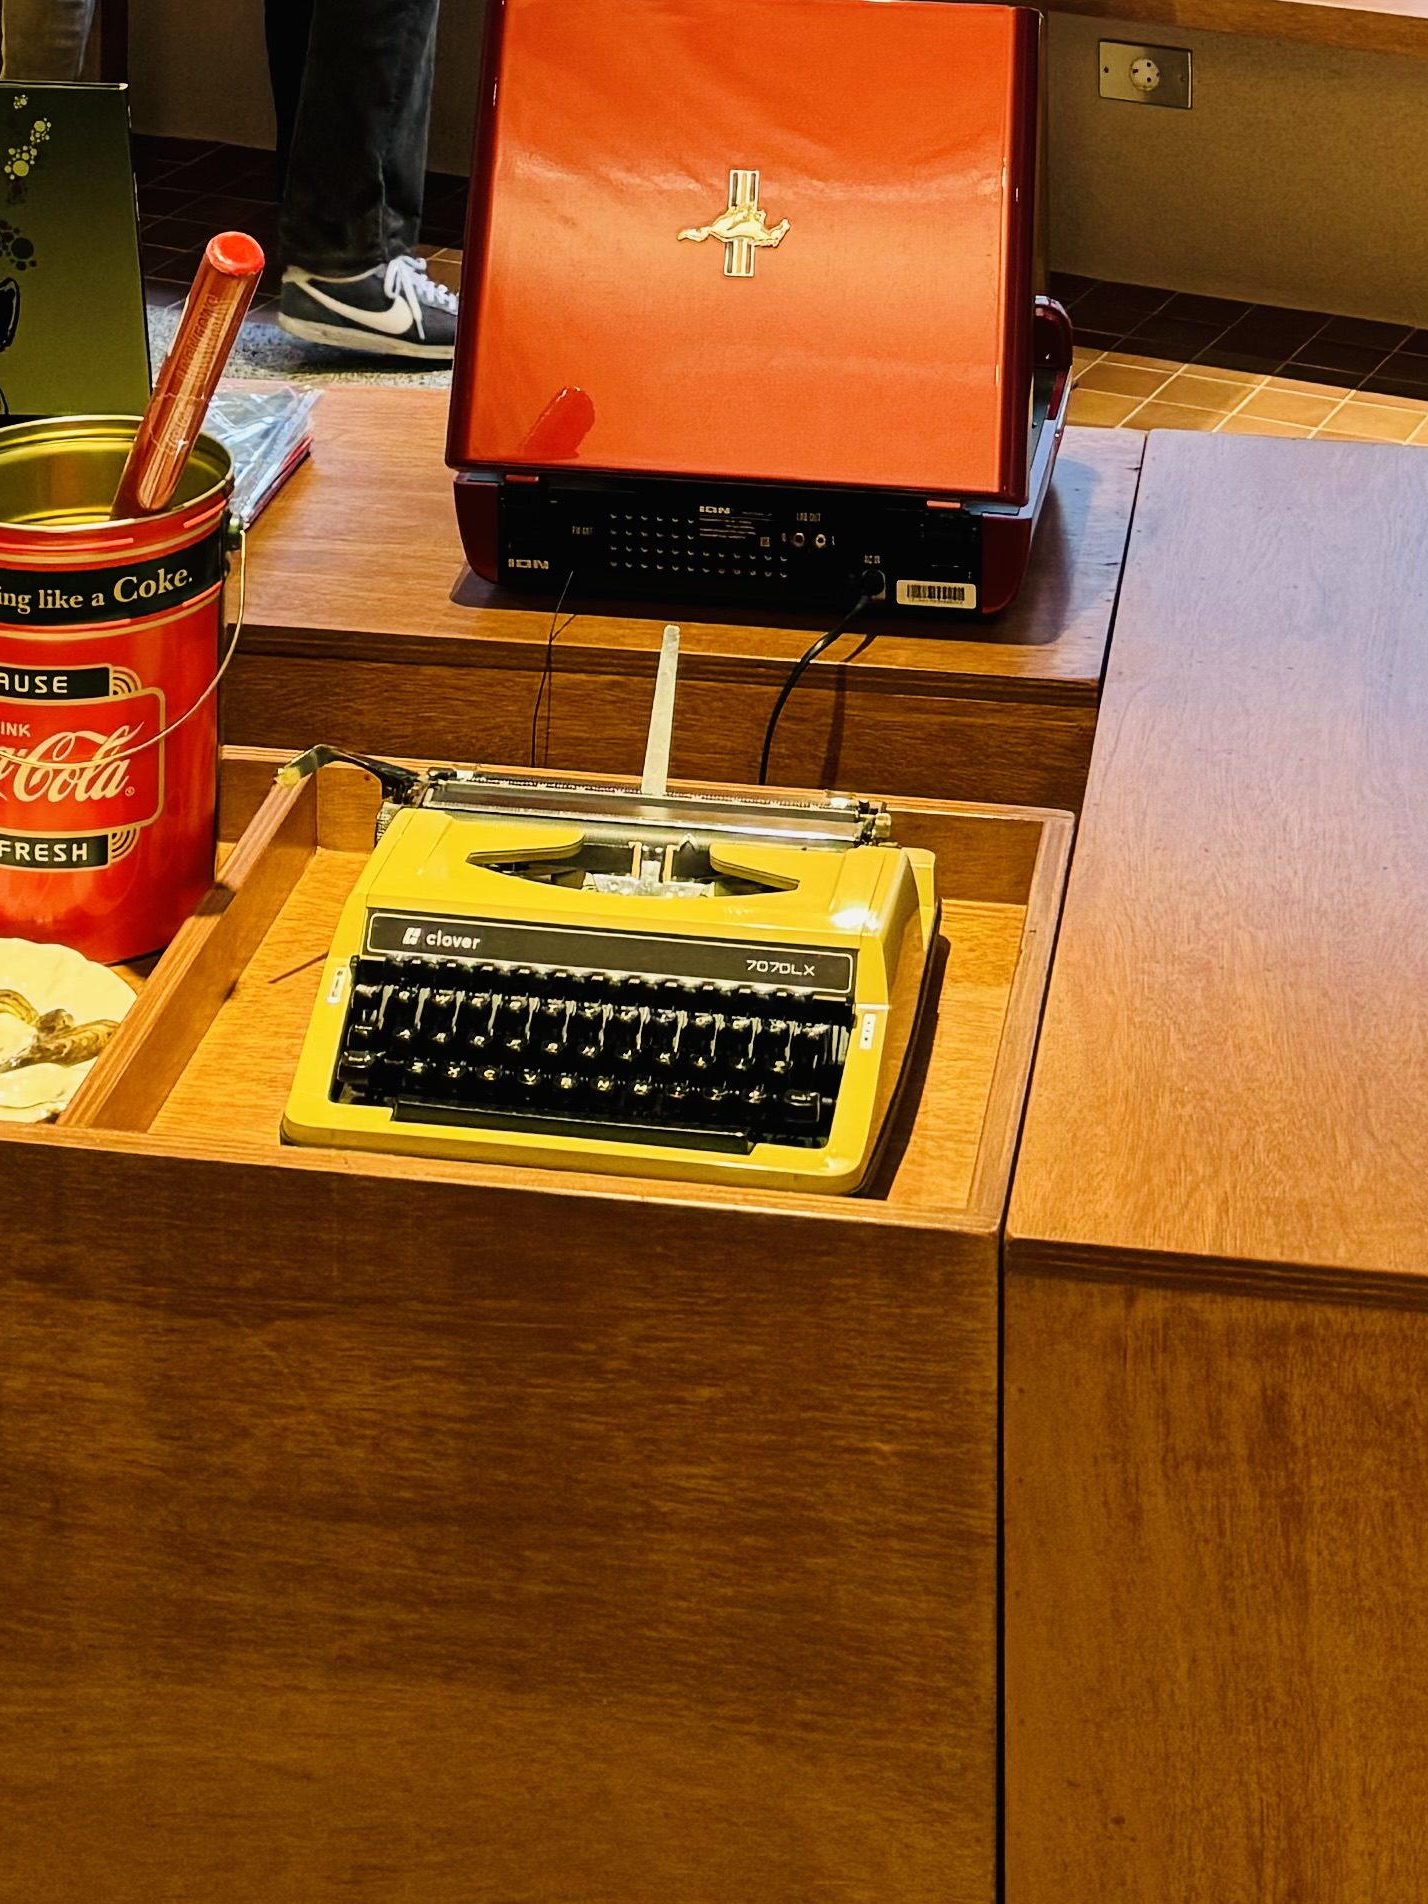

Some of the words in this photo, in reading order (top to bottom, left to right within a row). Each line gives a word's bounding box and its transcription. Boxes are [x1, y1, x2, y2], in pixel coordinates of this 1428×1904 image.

[699, 505, 731, 515] ION
[508, 558, 550, 570] ION
[38, 589, 84, 609] like
[91, 592, 105, 607] a
[113, 568, 193, 603] Coke.
[426, 929, 481, 950] clover
[746, 959, 815, 977] 7070LX
